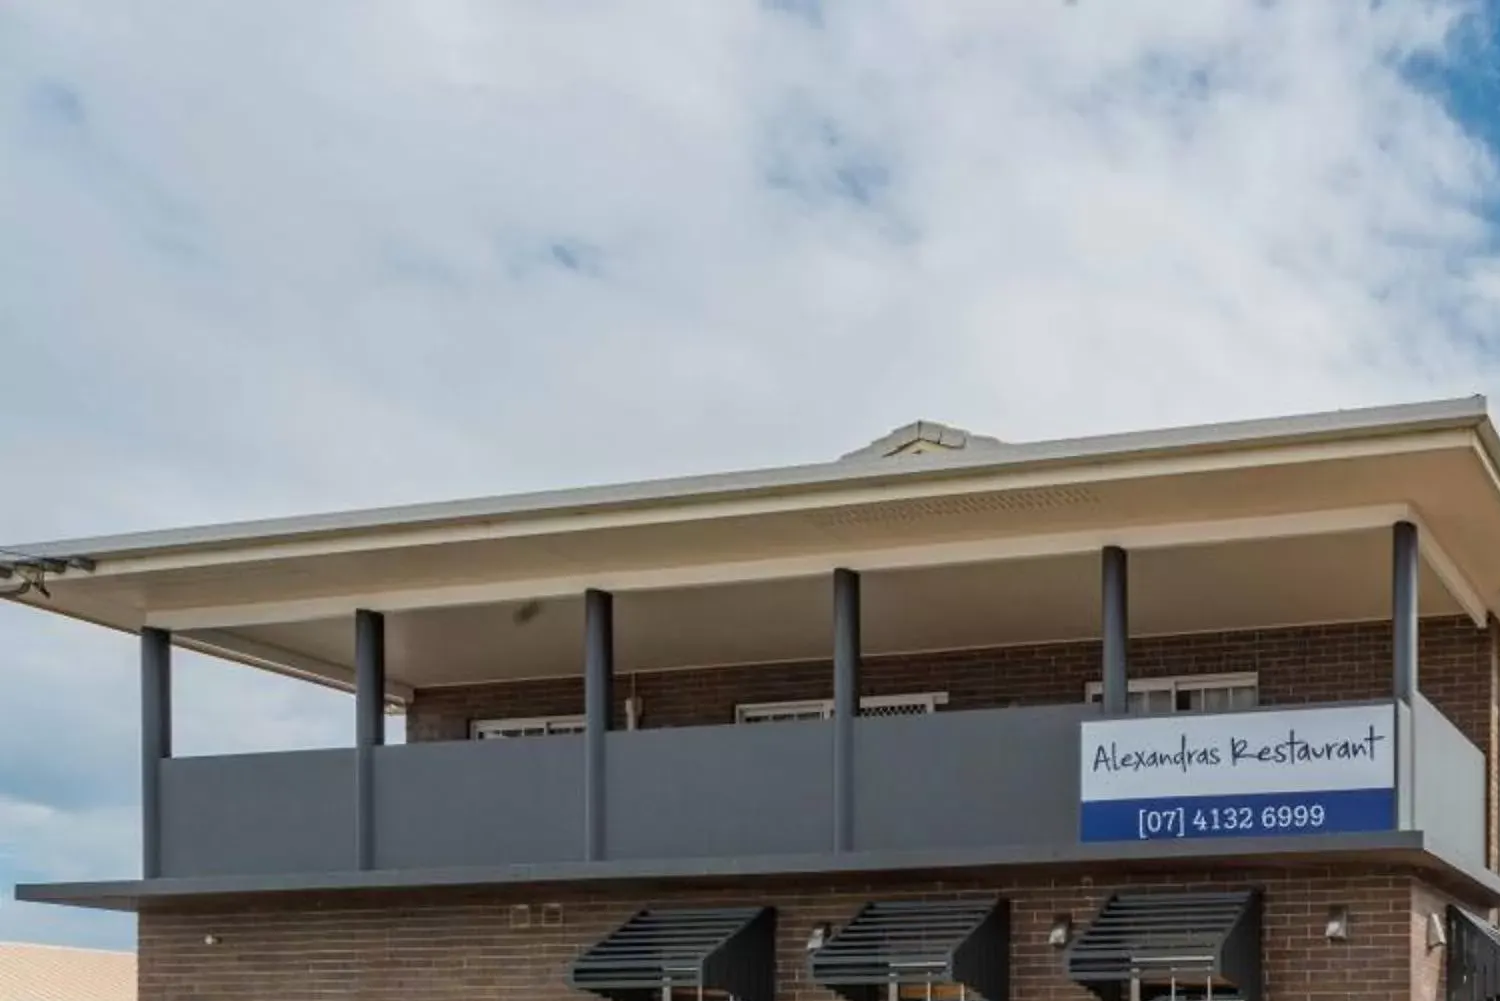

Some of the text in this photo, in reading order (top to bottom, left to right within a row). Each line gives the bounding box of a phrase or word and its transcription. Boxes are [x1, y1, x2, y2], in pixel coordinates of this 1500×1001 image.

[1092, 724, 1386, 772] Alexandras Restaurant
[1138, 804, 1326, 839] [07] 4132 6999
